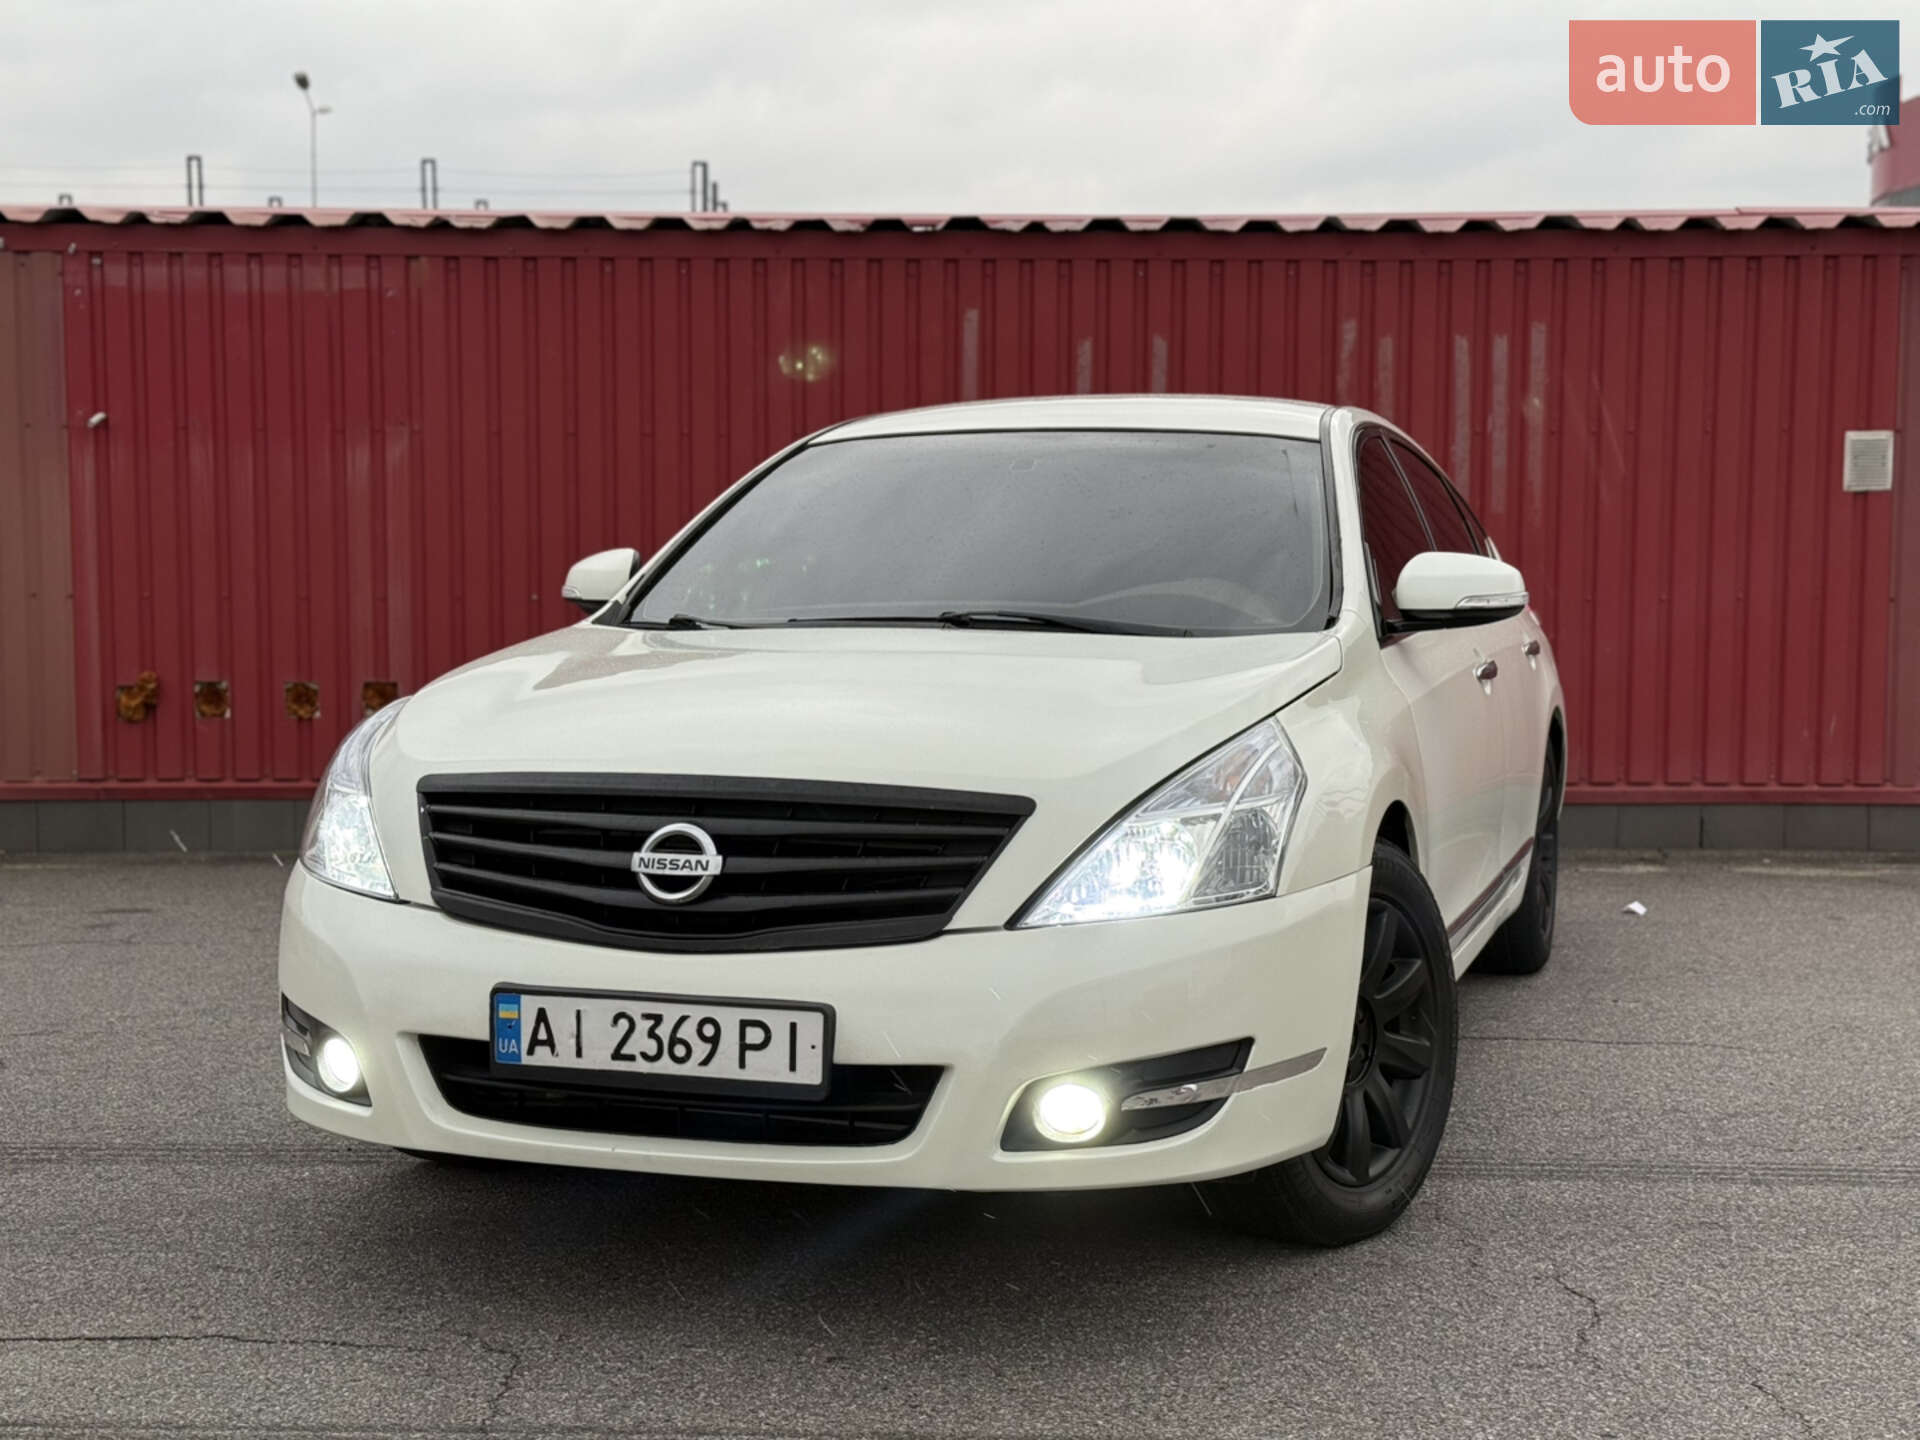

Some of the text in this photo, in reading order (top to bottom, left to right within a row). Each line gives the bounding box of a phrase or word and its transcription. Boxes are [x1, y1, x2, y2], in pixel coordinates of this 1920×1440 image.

[638, 857, 710, 872] NISSAN
[499, 1038, 519, 1055] UA
[526, 1007, 798, 1072] AI 2369 PI
